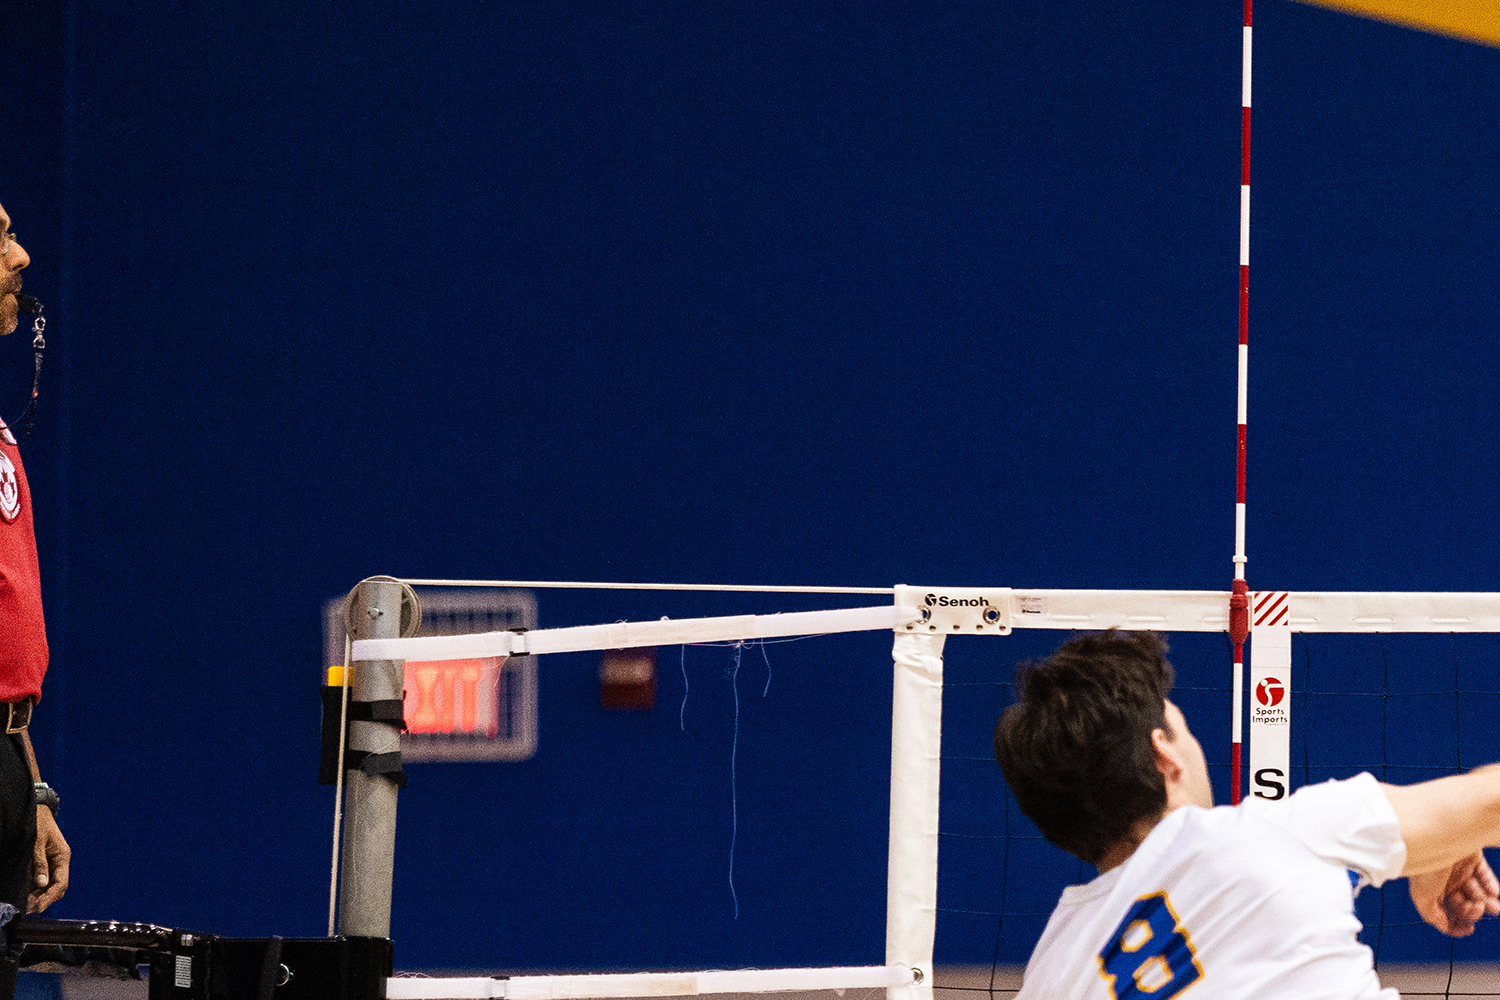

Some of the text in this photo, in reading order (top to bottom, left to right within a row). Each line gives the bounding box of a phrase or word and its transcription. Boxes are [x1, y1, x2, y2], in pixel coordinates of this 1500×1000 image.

[938, 595, 989, 607] Senoh
[1255, 707, 1285, 716] Sports
[1252, 715, 1288, 724] Imports
